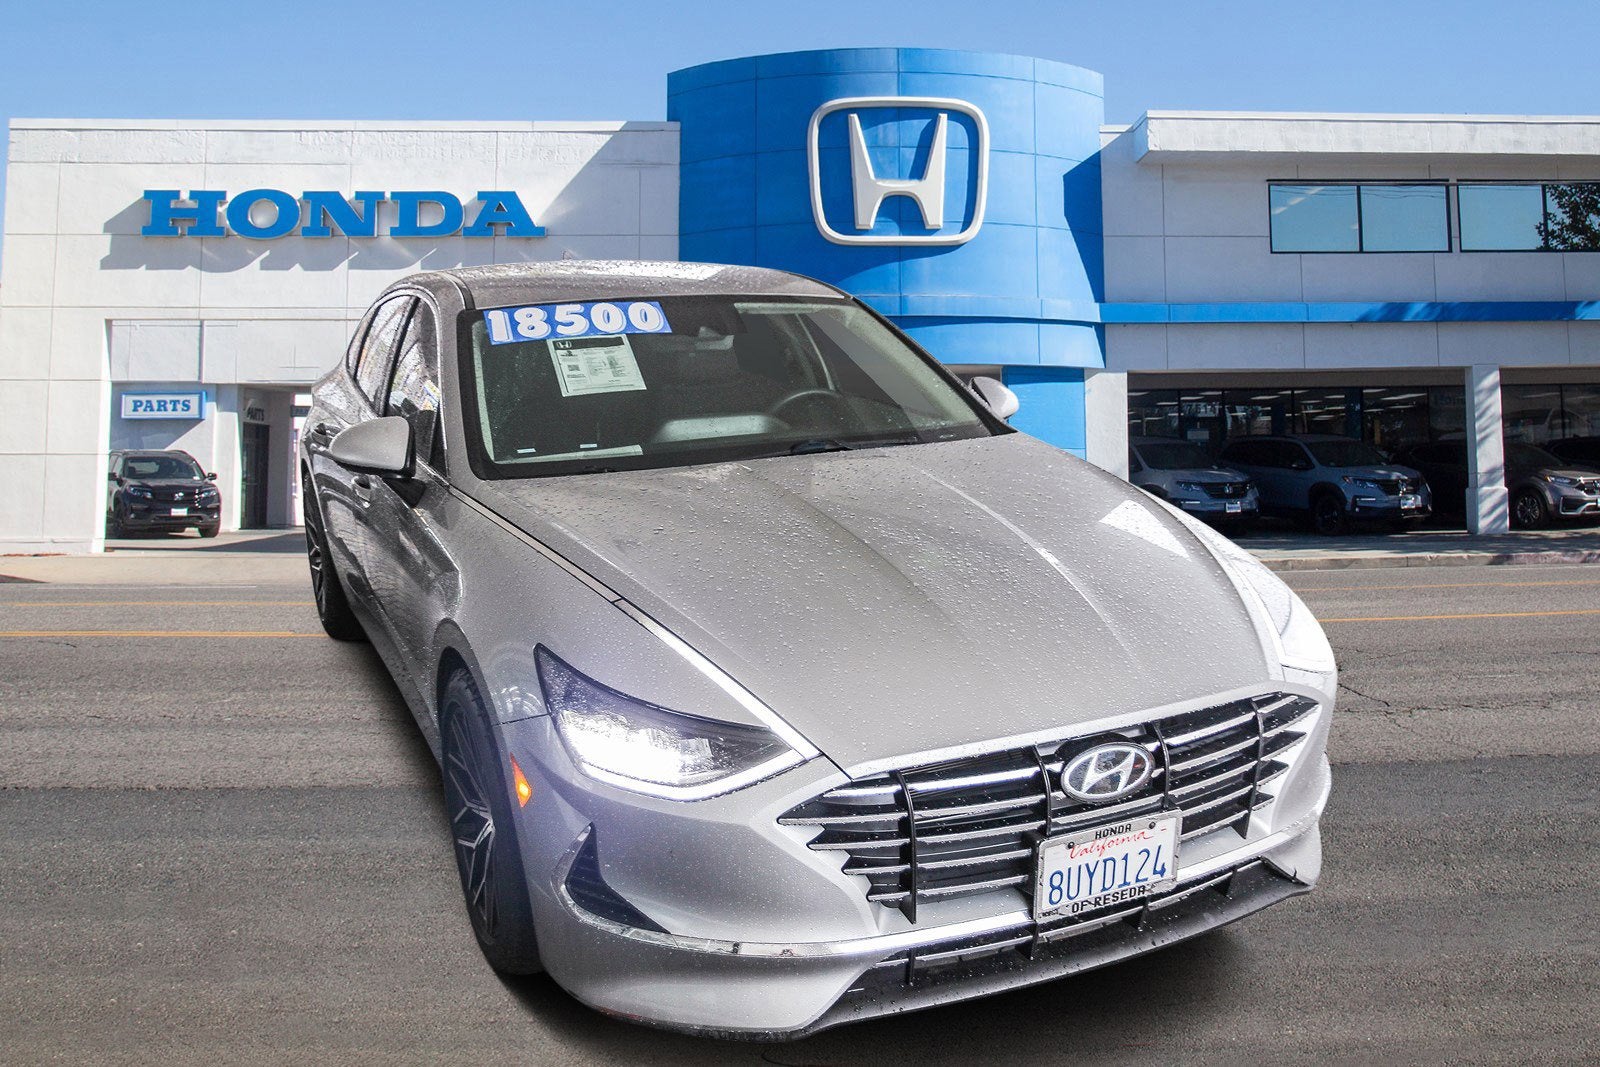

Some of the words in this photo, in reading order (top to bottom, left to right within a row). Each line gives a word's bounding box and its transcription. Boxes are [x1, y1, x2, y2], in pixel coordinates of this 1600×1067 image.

[142, 187, 547, 239] HONDA
[486, 301, 664, 342] 18500
[131, 399, 192, 413] PARTS
[1069, 831, 1153, 859] California
[1095, 824, 1132, 840] HONDA
[1048, 845, 1167, 906] 8UYD124
[1071, 900, 1088, 913] OF
[1093, 886, 1146, 908] RESEDA
